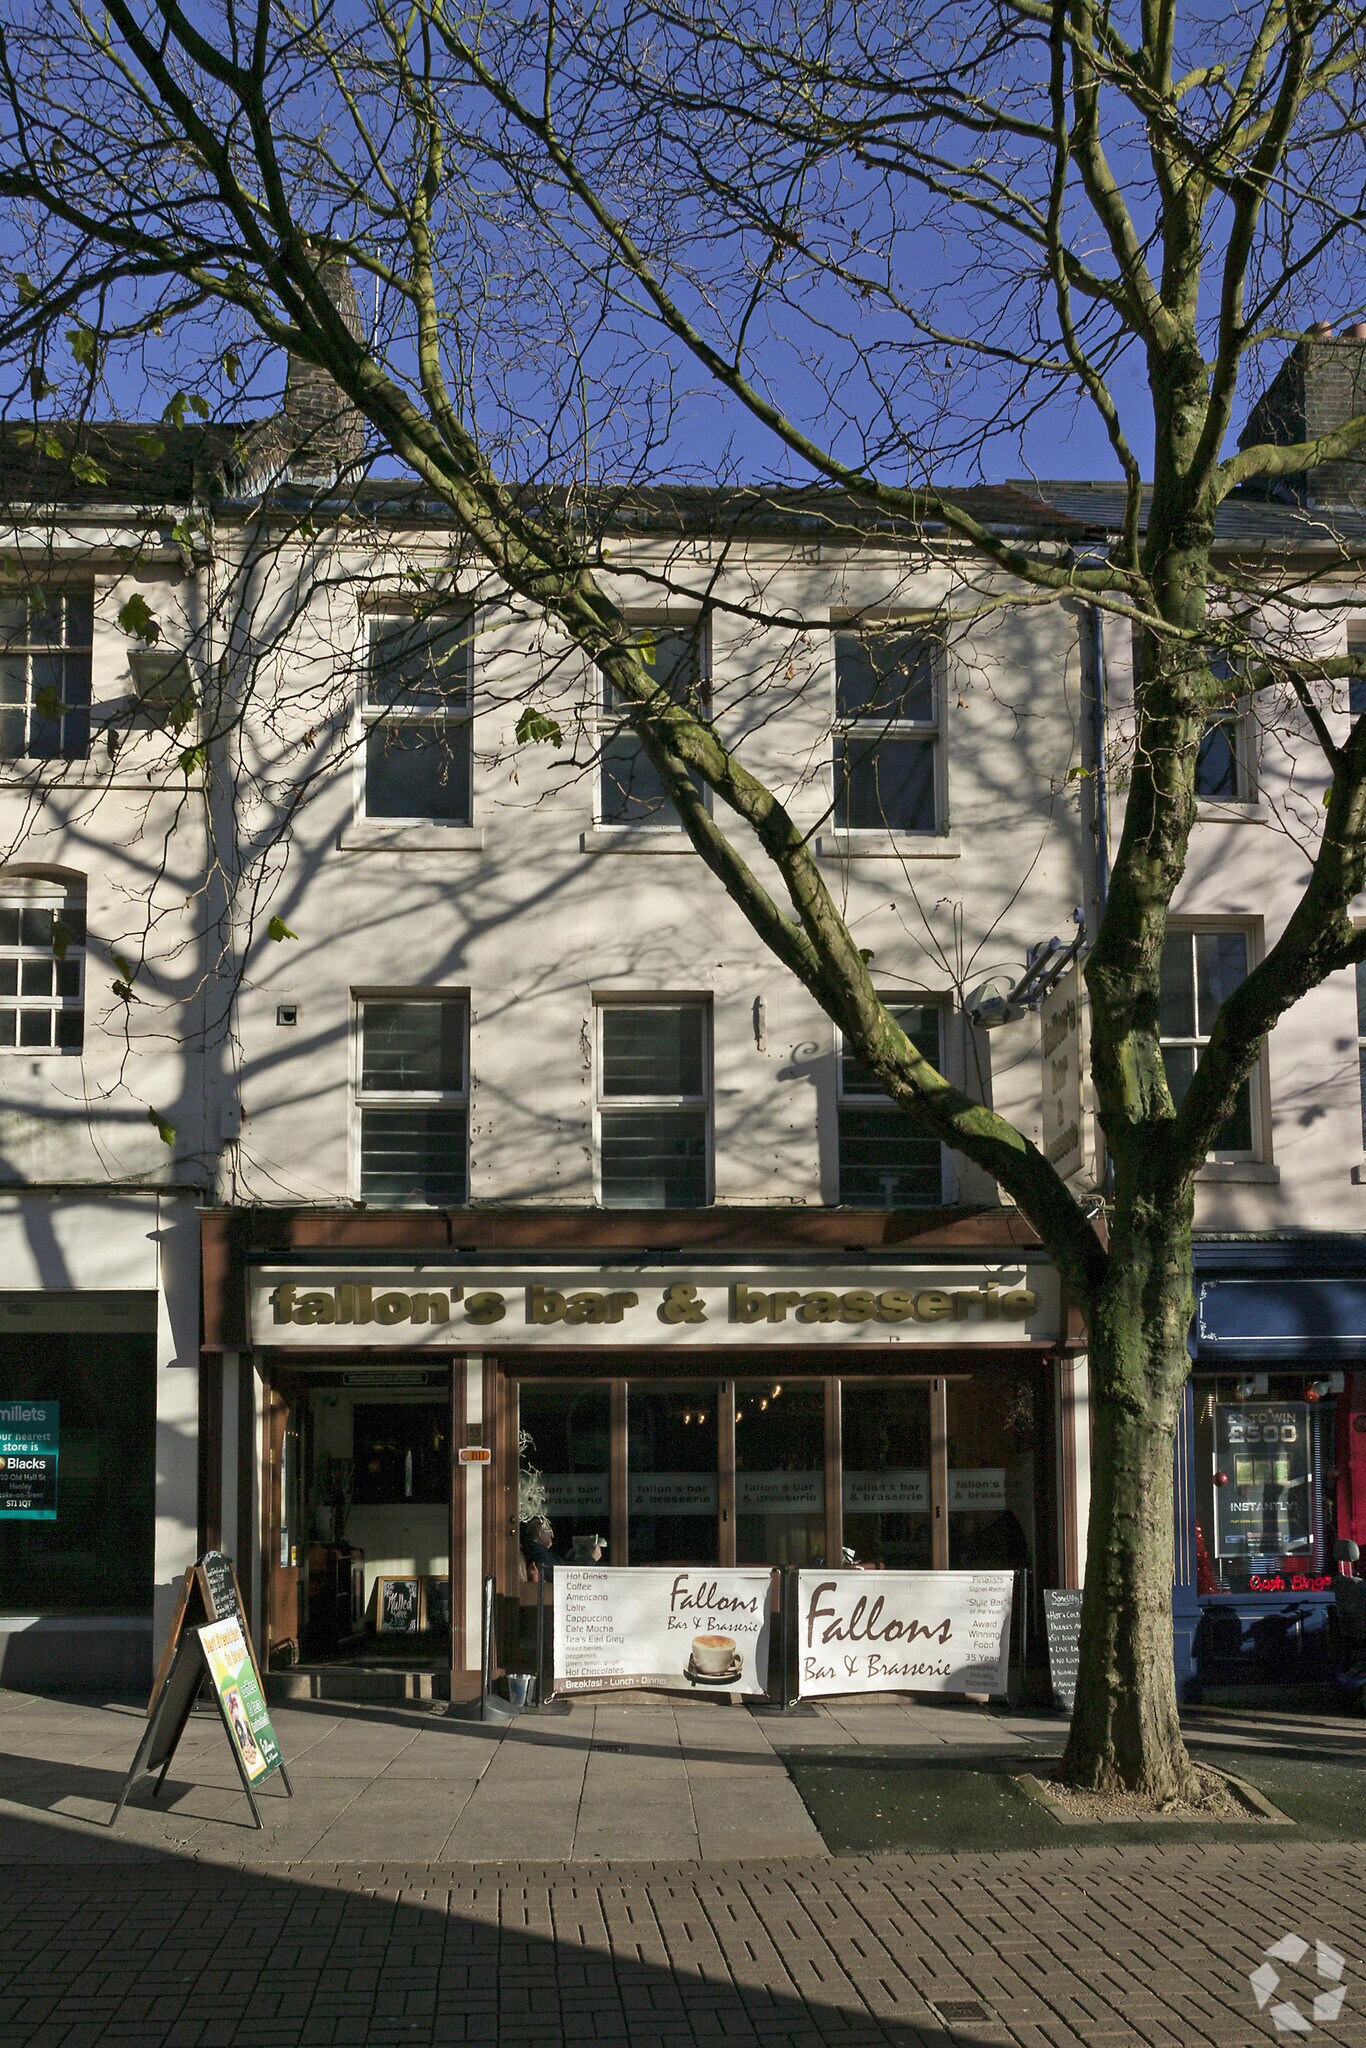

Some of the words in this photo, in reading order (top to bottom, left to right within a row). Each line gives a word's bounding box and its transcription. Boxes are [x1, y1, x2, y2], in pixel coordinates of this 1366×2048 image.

[271, 1284, 506, 1325] fallon's
[527, 1284, 639, 1325] bar
[659, 1283, 708, 1324] &
[730, 1283, 1039, 1324] brasserie
[1249, 1413, 1267, 1423] TO
[1271, 1412, 1296, 1423] WIN
[0, 1433, 12, 1441] our
[15, 1432, 51, 1441] nearest
[469, 1427, 481, 1438] 55
[1228, 1425, 1297, 1443] £500
[3, 1443, 28, 1451] store
[30, 1442, 39, 1451] is
[7, 1457, 46, 1469] Blacks
[10, 1473, 22, 1481] Old
[24, 1473, 37, 1481] Hall
[637, 1484, 682, 1493] fallon's
[686, 1484, 708, 1493] bar
[744, 1483, 790, 1492] fallon's
[793, 1483, 814, 1492] bar
[851, 1483, 896, 1492] fallon's
[900, 1482, 921, 1492] bar
[956, 1480, 1000, 1489] fallon's
[578, 1486, 599, 1495] bar
[954, 1491, 963, 1499] &
[635, 1495, 644, 1503] &
[650, 1495, 711, 1503] brasserie
[756, 1493, 817, 1502] brasserie
[849, 1493, 859, 1502] &
[863, 1493, 923, 1502] brasserie
[566, 1572, 581, 1580] Hot
[582, 1572, 608, 1580] Drinks
[972, 1575, 1004, 1584] Finalists
[566, 1582, 592, 1591] Coffee
[1249, 1575, 1286, 1590] Cash
[566, 1593, 608, 1602] Americano
[670, 1574, 758, 1613] Fallons
[566, 1603, 586, 1612] Latte
[565, 1614, 613, 1624] Cappuccino
[806, 1581, 953, 1649] Fallons
[667, 1616, 688, 1630] Bar
[693, 1616, 702, 1631] &
[707, 1616, 759, 1632] Brasserie
[972, 1620, 997, 1629] Award
[566, 1625, 584, 1633] Cafe
[586, 1625, 614, 1633] Mocha
[968, 1630, 1001, 1640] Winning
[565, 1635, 586, 1643] Tea's
[588, 1635, 604, 1643] Earl
[606, 1635, 625, 1645] Grey
[973, 1641, 994, 1649] Food
[965, 1654, 976, 1662] 35
[978, 1655, 1001, 1663] Years
[566, 1668, 579, 1676] Hot
[581, 1667, 624, 1675] Chocolates
[804, 1656, 837, 1682] Bar
[844, 1655, 859, 1677] &
[867, 1654, 951, 1678] Brasserie
[966, 1663, 999, 1673] Hospitality
[969, 1672, 995, 1681] Industry
[565, 1679, 603, 1689] Breakfast
[610, 1677, 634, 1687] Lunch
[641, 1676, 667, 1685] Dinner
[965, 1680, 998, 1688] Experience
